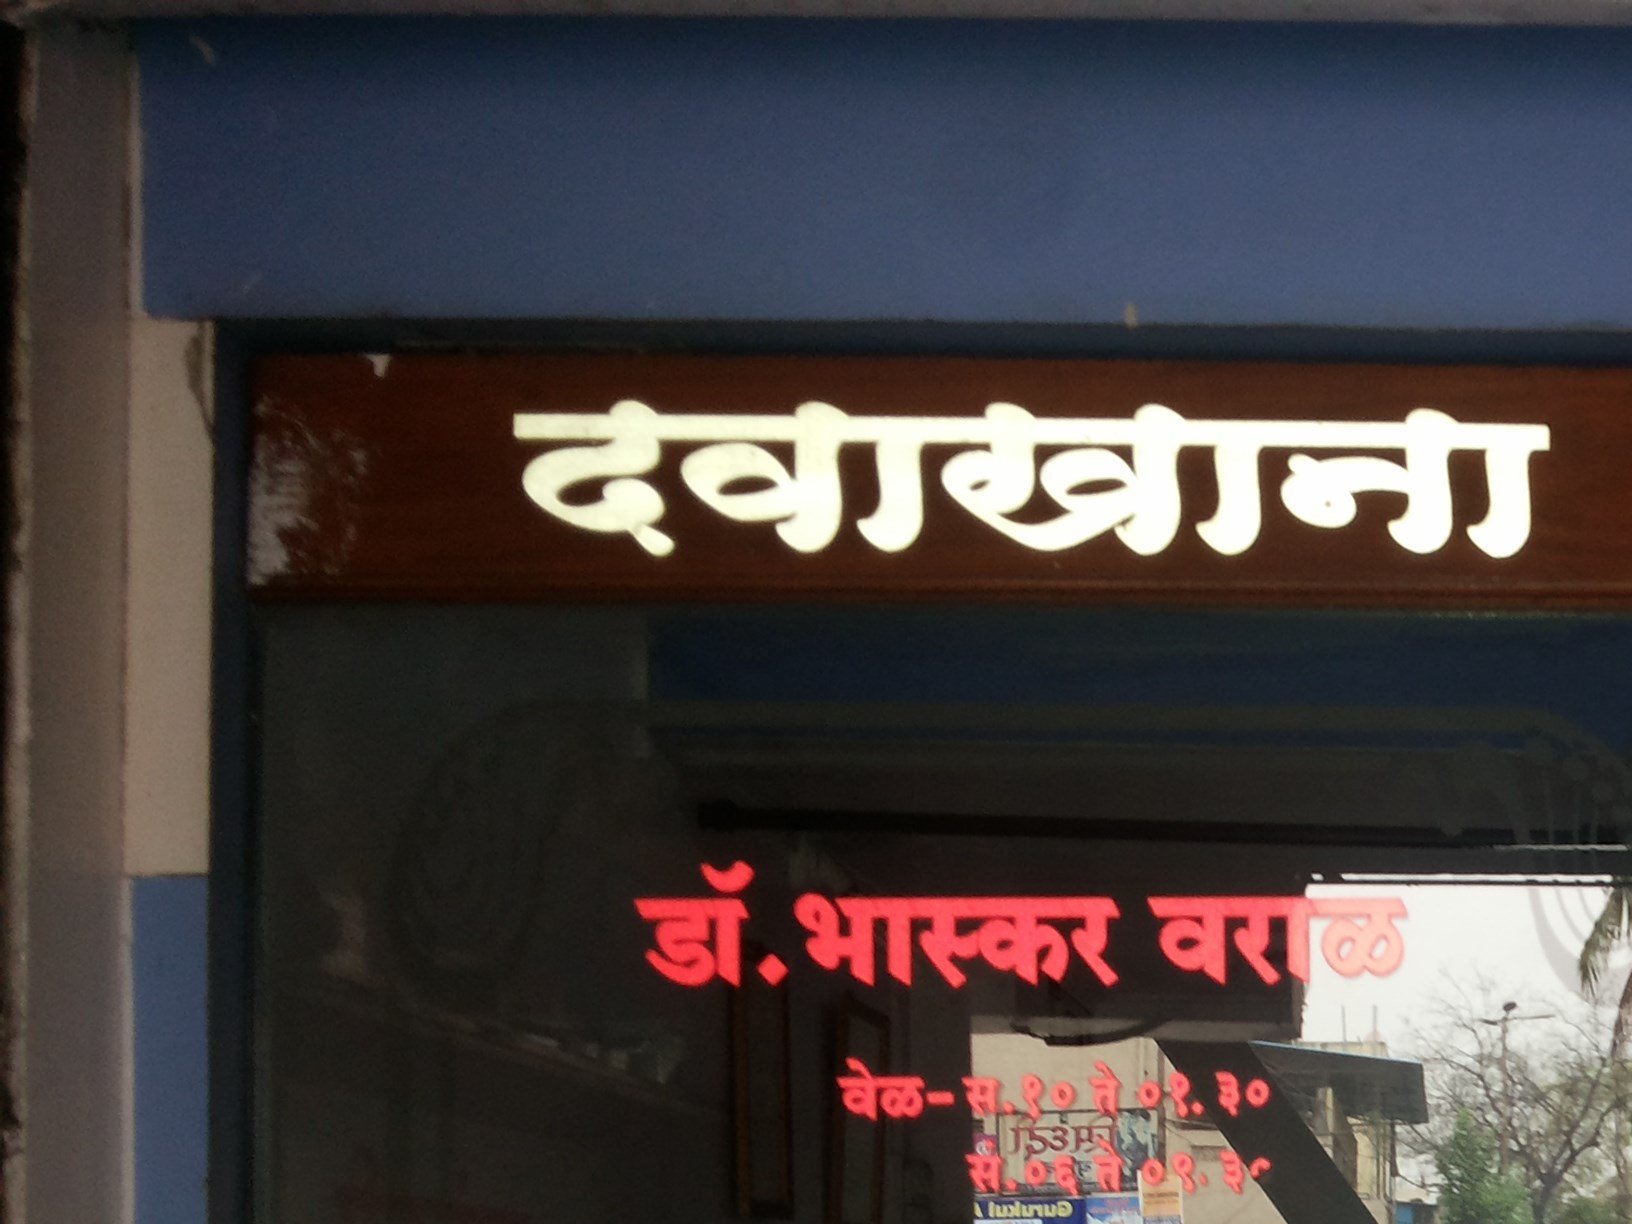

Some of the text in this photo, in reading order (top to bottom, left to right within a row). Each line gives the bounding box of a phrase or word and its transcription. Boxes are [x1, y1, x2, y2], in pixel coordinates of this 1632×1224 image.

[514, 400, 1550, 559] दवाखाना
[1147, 895, 1408, 986] वराळ
[1088, 1060, 1122, 1117] ते
[1092, 1137, 1125, 1193] ते
